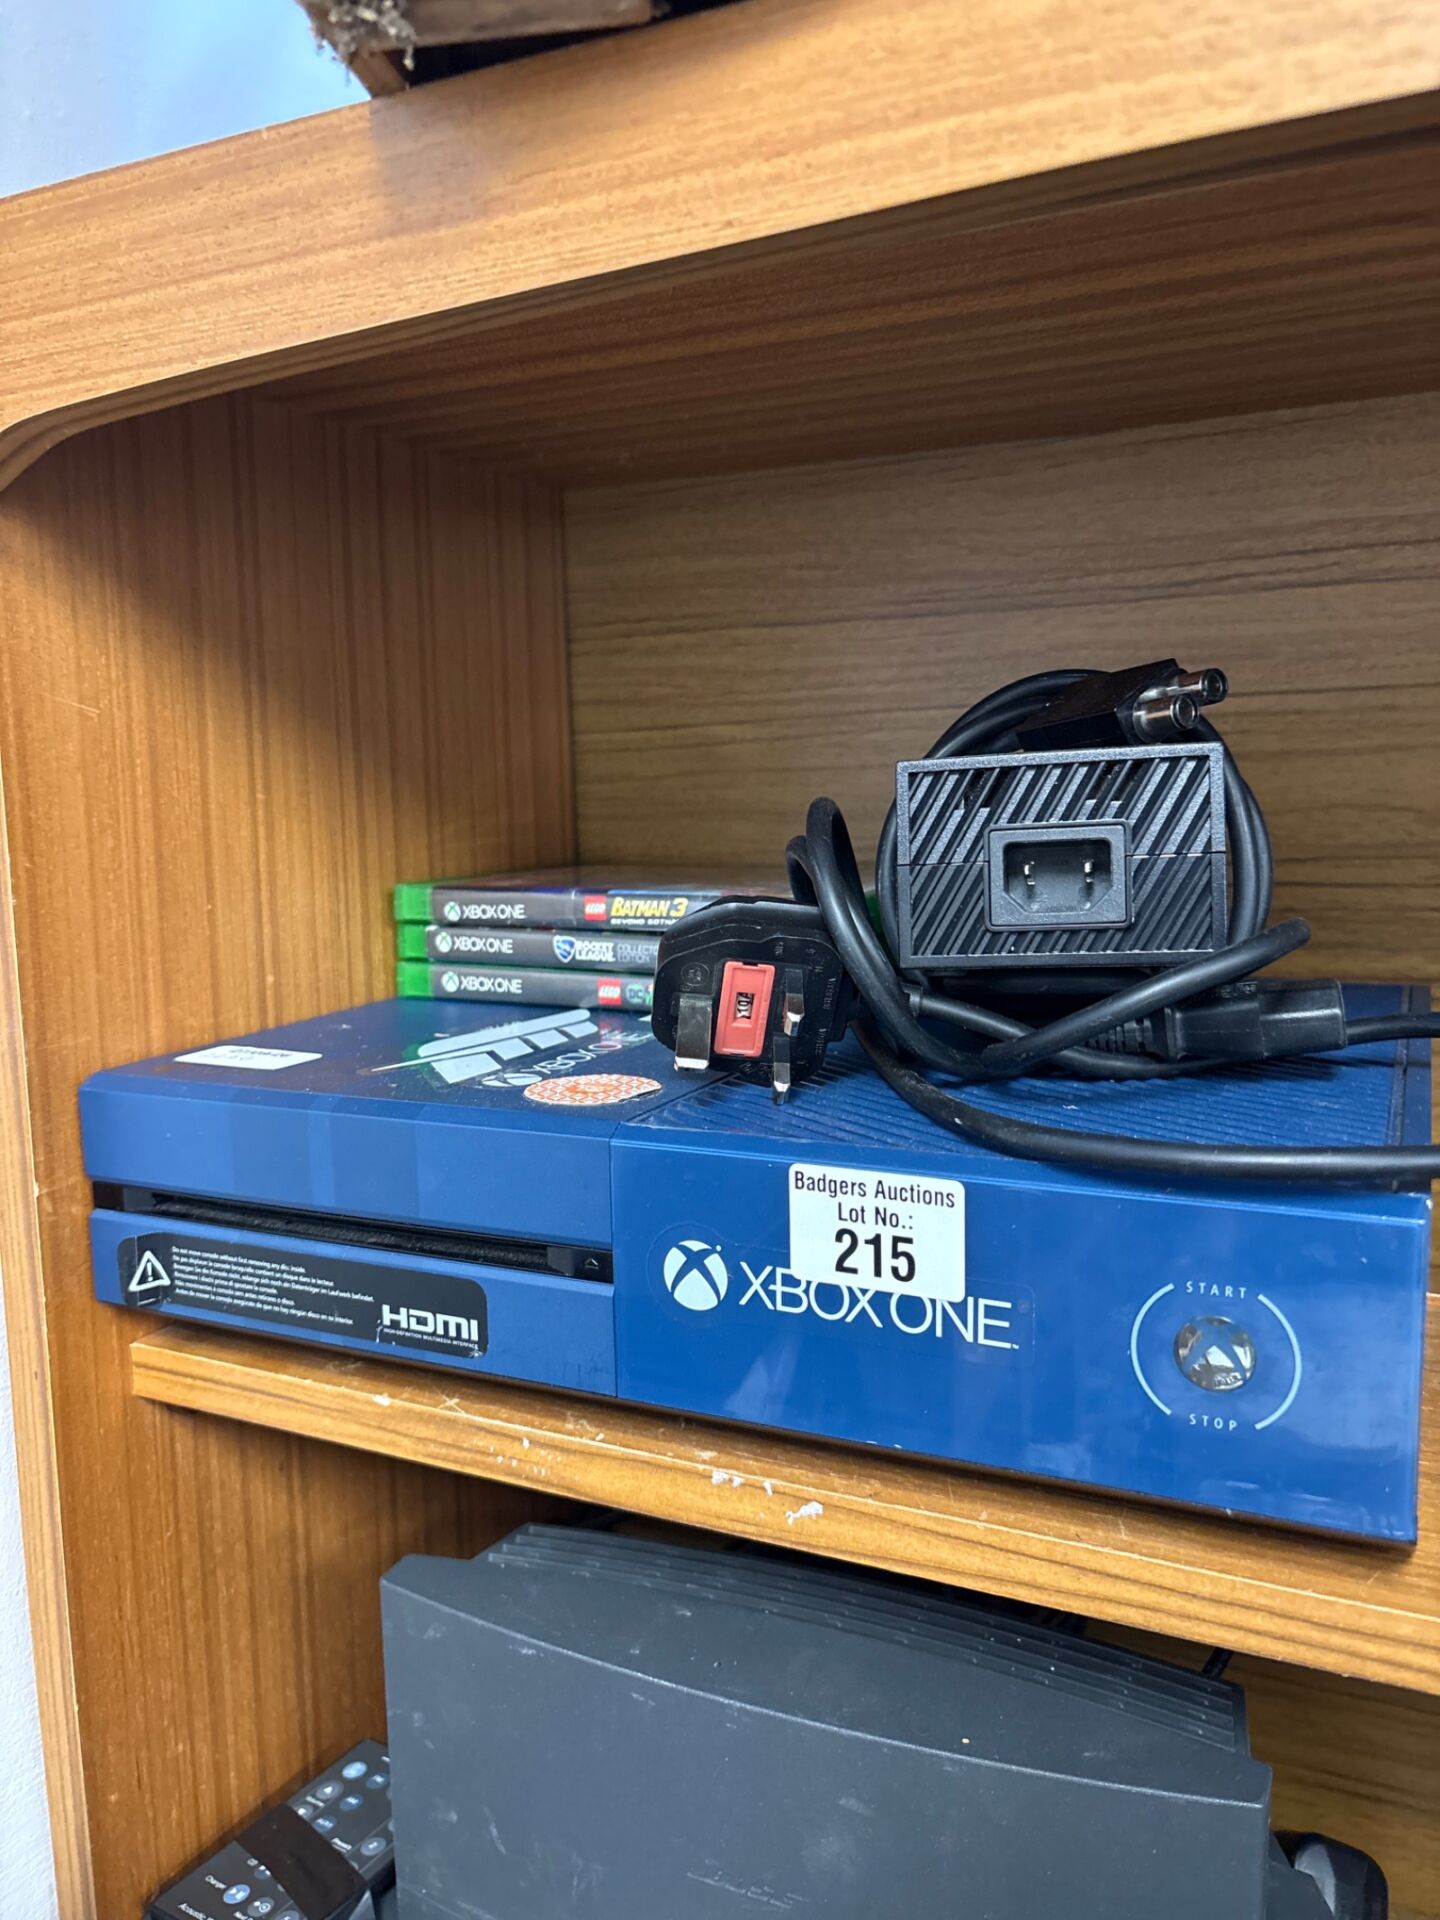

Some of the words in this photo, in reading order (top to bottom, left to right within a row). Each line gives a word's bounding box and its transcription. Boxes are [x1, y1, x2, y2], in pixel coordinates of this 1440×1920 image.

[462, 904, 497, 919] XBOX
[497, 905, 526, 920] ONE
[585, 902, 606, 914] LEGO
[610, 897, 670, 917] BATMAN
[669, 897, 688, 917] 3
[453, 936, 487, 951] XBOX
[487, 938, 513, 953] ONE
[575, 940, 615, 952] ROCKET
[575, 950, 616, 962] LEAGUE
[460, 977, 496, 993] XBOX
[496, 979, 522, 994] ONE
[597, 985, 621, 999] LEGO
[794, 1171, 867, 1200] Badgers
[874, 1179, 956, 1209] Auctions
[837, 1202, 867, 1225] Lot
[875, 1205, 914, 1230] No.:
[834, 1228, 916, 1284] 215
[1186, 1280, 1247, 1299] START
[739, 1261, 883, 1329] XBOX
[889, 1291, 1012, 1350] ONE
[382, 1303, 479, 1342] HDMI
[1189, 1413, 1238, 1431] STOP
